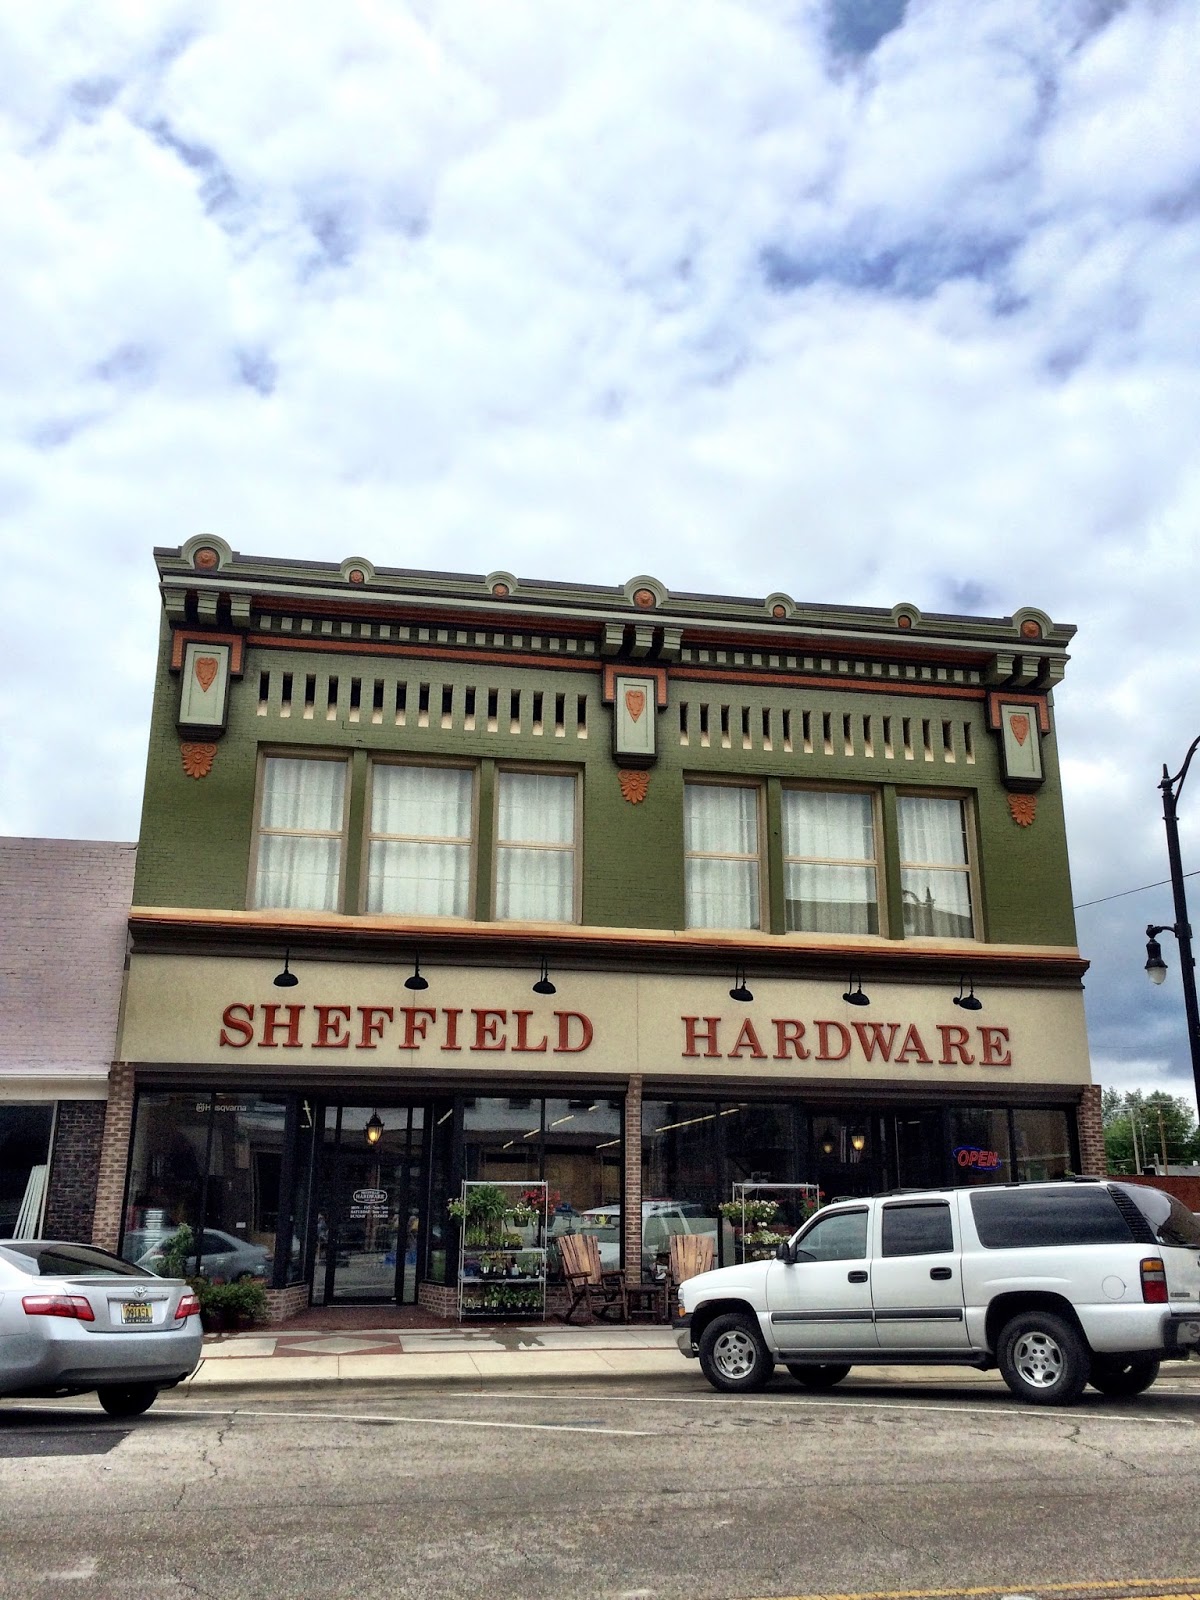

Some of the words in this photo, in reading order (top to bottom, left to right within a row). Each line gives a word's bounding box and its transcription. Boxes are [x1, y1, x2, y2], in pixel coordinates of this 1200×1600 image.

[219, 1002, 594, 1052] SHEFFIELD
[680, 1016, 1012, 1066] HARDWARE
[204, 1103, 247, 1112] Hsqvarna
[957, 1150, 998, 1167] OPEN
